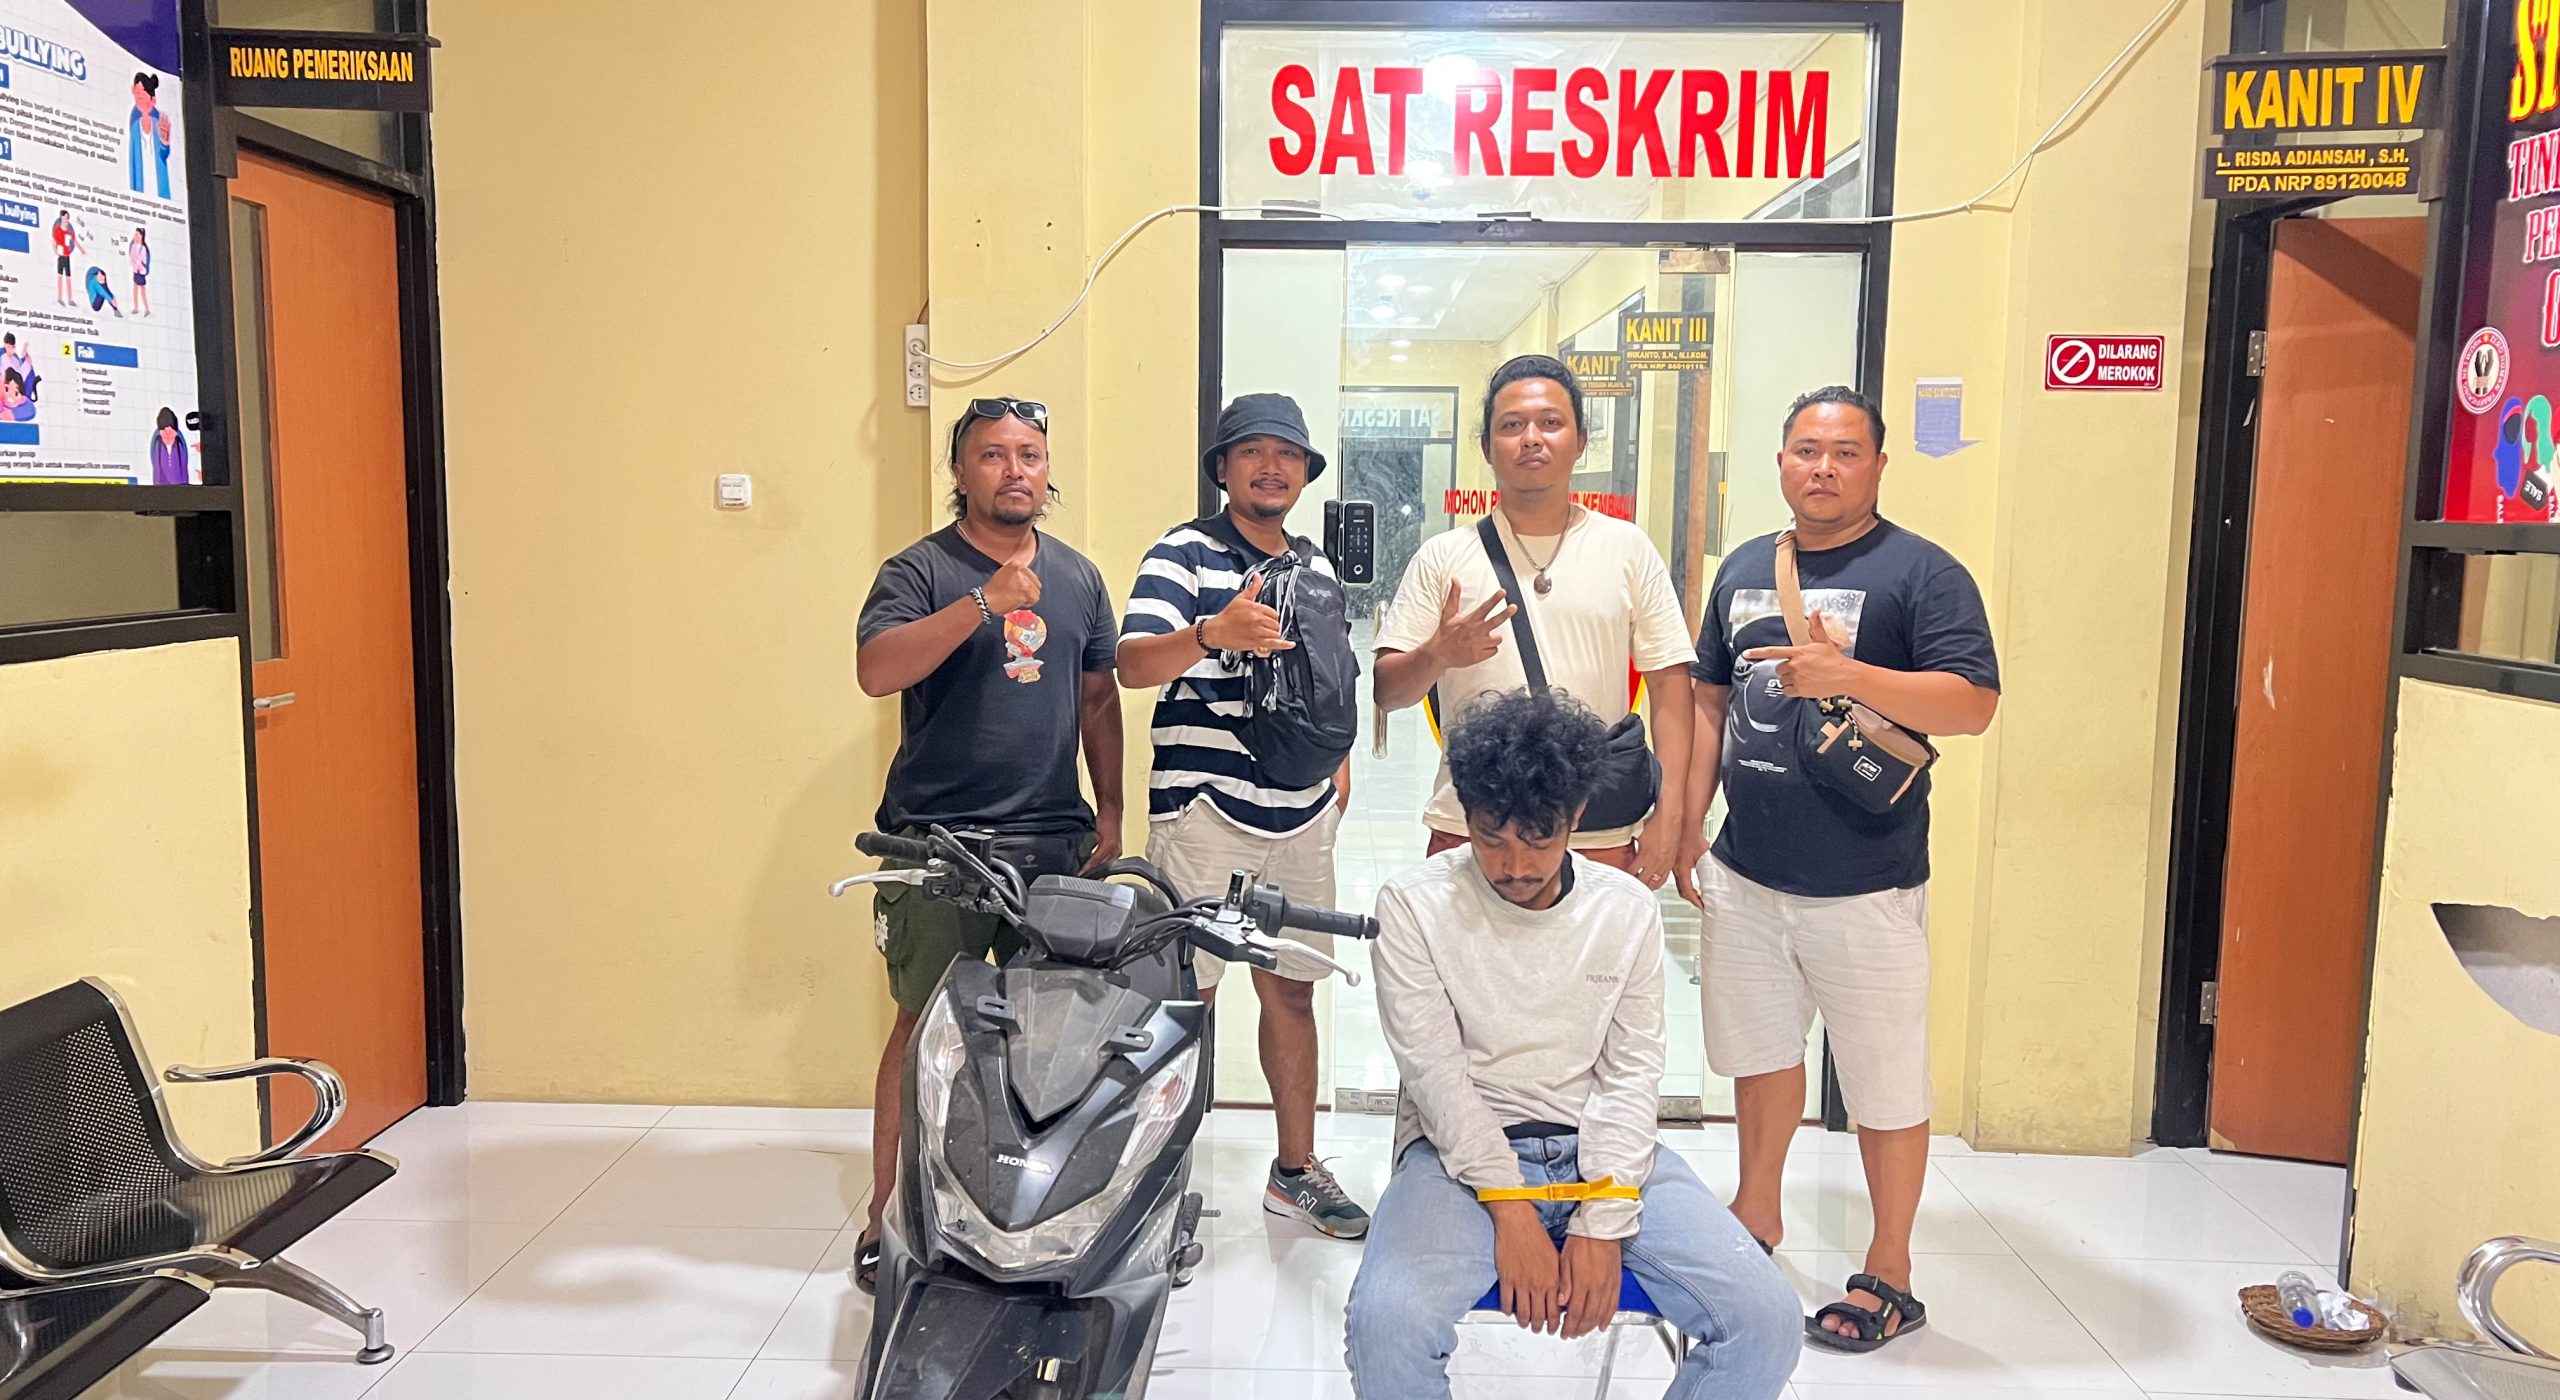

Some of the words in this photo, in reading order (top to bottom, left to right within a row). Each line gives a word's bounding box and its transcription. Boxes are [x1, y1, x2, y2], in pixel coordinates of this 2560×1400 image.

[230, 47, 288, 79] RUANG
[293, 48, 413, 82] PEMERIKSAAN
[2224, 67, 2364, 129] KANIT
[2377, 65, 2424, 124] IV
[1268, 64, 1423, 177] SAT
[1454, 66, 1828, 179] RESKRIM
[2217, 152, 2231, 169] L.
[2235, 150, 2282, 168] RISDA
[2285, 149, 2366, 166] ADIANSAH
[2379, 148, 2410, 164] S.H.
[2228, 176, 2270, 193] IPDA
[2274, 175, 2312, 192] NRP
[2313, 172, 2407, 191] 89120048
[4, 202, 37, 225] bullying
[1626, 317, 1683, 343] KANIT
[1689, 317, 1708, 342] III
[64, 345, 70, 355] 2
[2098, 344, 2158, 360] DILARANG
[1566, 354, 1621, 376] KANIT
[2097, 365, 2156, 382] MEROKOK
[2524, 480, 2543, 501] SALE
[1443, 489, 1487, 515] MOHON
[1296, 1190, 1318, 1213] N
